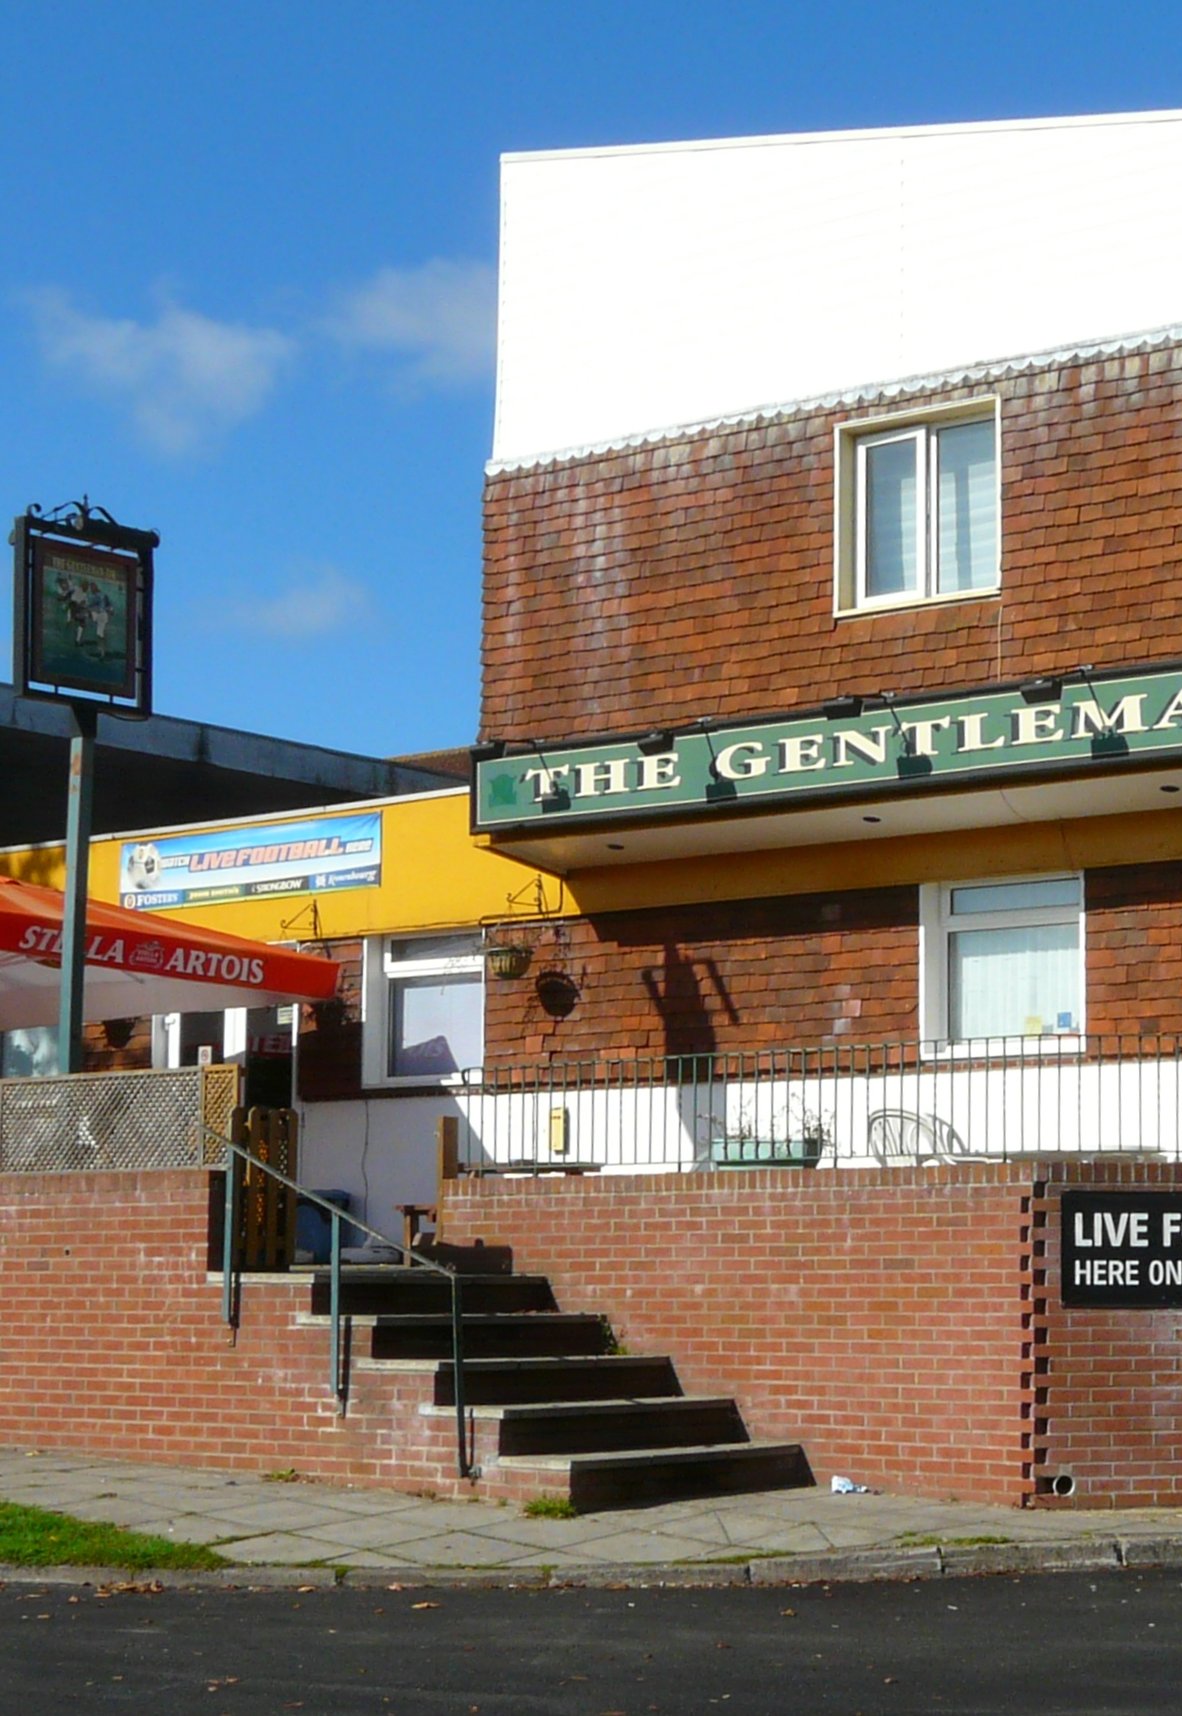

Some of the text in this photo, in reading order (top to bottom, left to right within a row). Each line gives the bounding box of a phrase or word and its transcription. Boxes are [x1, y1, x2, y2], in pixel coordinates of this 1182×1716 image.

[525, 752, 682, 802] THE
[235, 837, 344, 868] FOOTBALL
[164, 947, 265, 984] ARTOIS
[1074, 1212, 1149, 1248] LIVE
[1074, 1259, 1140, 1286] HERE
[1148, 1259, 1182, 1286] ON
